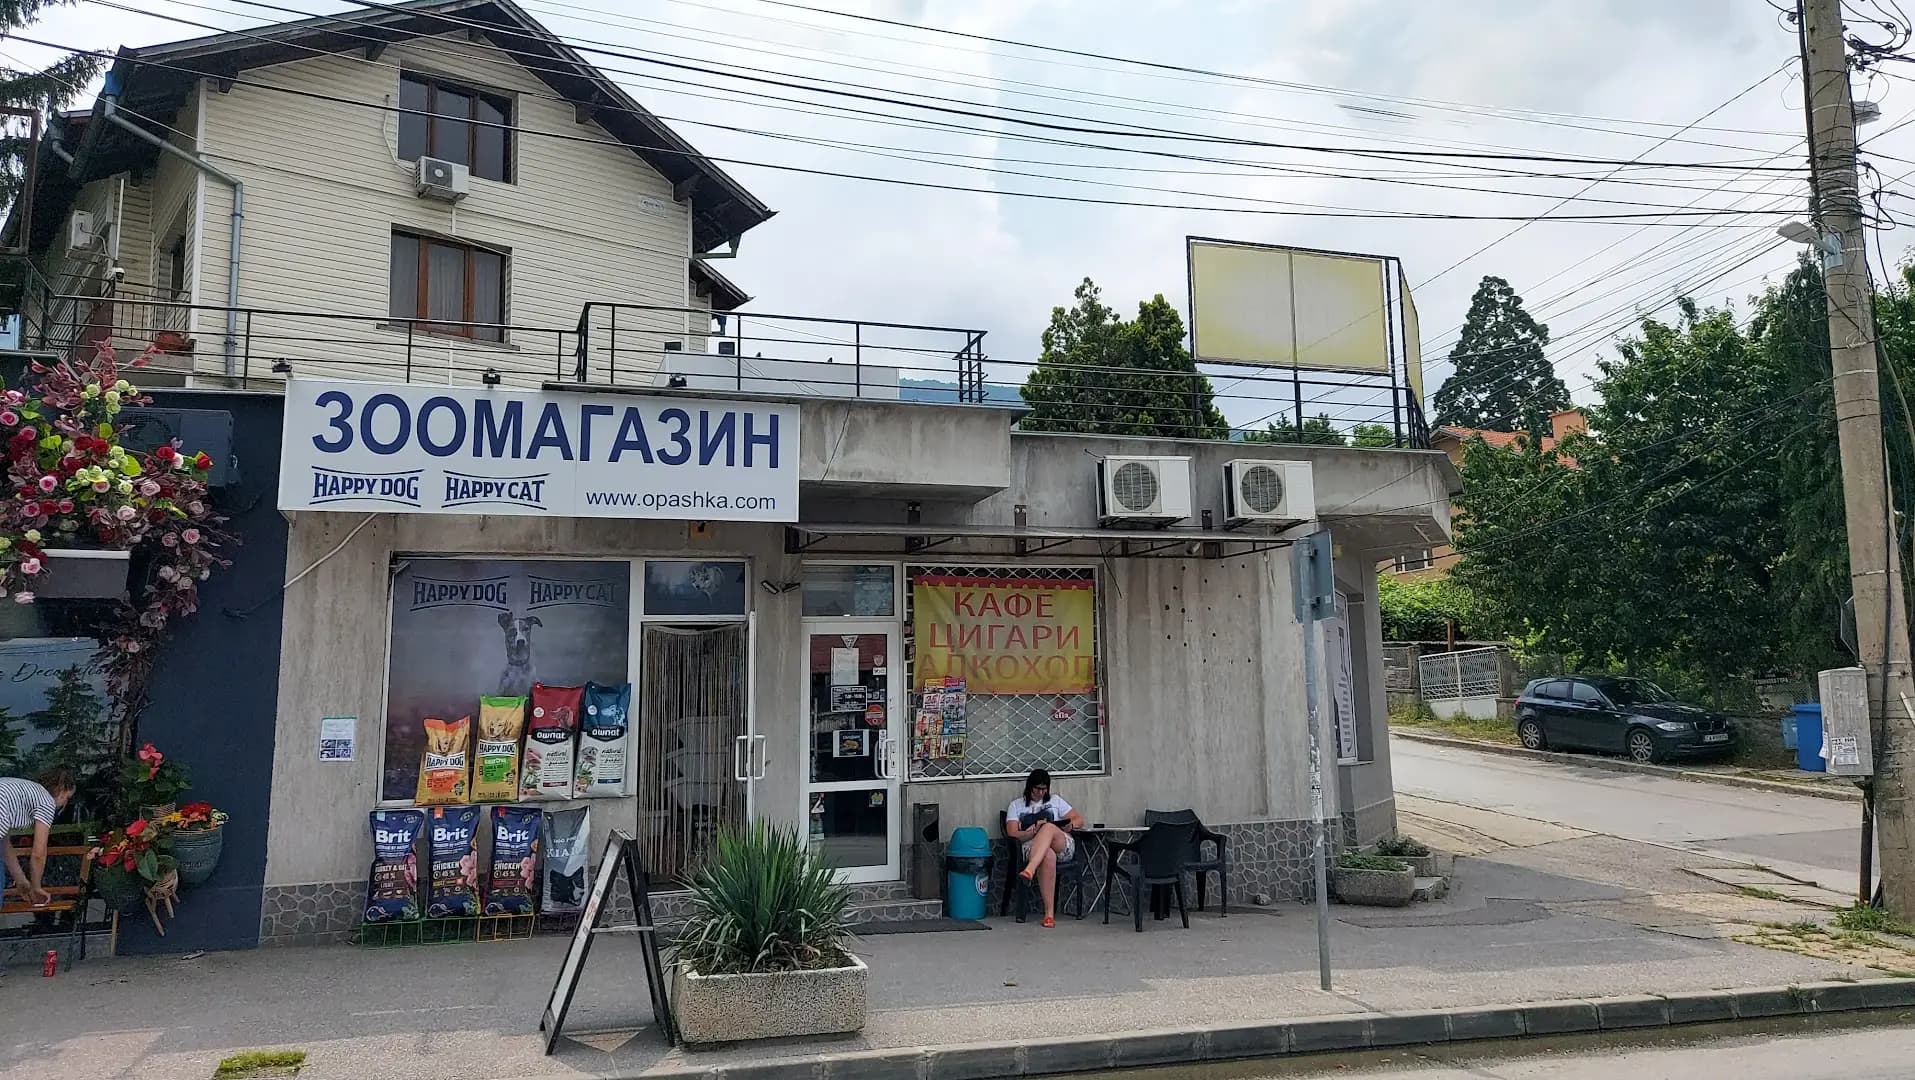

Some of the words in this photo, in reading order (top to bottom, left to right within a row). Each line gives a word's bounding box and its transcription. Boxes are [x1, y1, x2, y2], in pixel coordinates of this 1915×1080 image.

[312, 390, 780, 469] ЗООМАГАЗИН
[313, 473, 378, 499] HAPPY
[380, 475, 420, 501] DOG
[445, 475, 507, 502] HAPPY
[507, 479, 546, 503] CAT
[586, 489, 776, 510] www.opashka.com
[413, 581, 472, 606] HAPPY
[472, 582, 507, 605] DOG
[529, 581, 583, 605] HAPPY
[584, 584, 617, 604] CAT
[954, 592, 1056, 618] КАФЕ
[929, 623, 1079, 653] ЦИГАРИ
[536, 731, 566, 740] ownat
[591, 728, 620, 737] ownat
[479, 743, 502, 754] HAPPY
[426, 756, 449, 768] HAPPY
[449, 756, 464, 767] DOG
[375, 829, 412, 844] Brit
[433, 827, 469, 841] Brit
[496, 825, 529, 842] Brit
[432, 862, 460, 872] CHICKEN
[493, 862, 520, 871] CHICKEN
